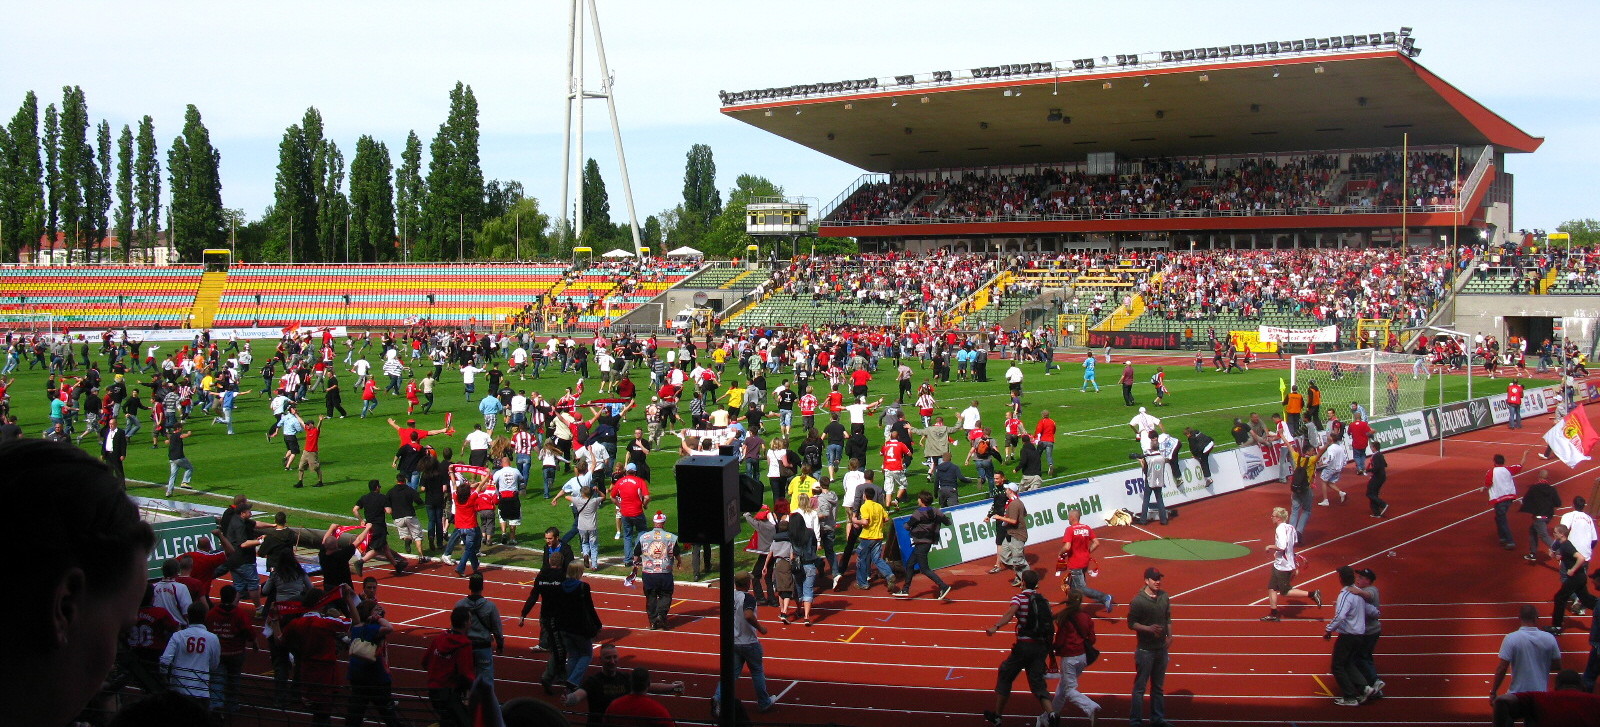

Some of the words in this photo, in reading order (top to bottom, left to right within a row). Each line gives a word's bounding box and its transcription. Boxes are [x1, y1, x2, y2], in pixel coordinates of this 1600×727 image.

[1129, 333, 1176, 349] Köpenik
[886, 446, 895, 459] 4
[1056, 494, 1103, 521] GmbH
[186, 636, 206, 654] 66
